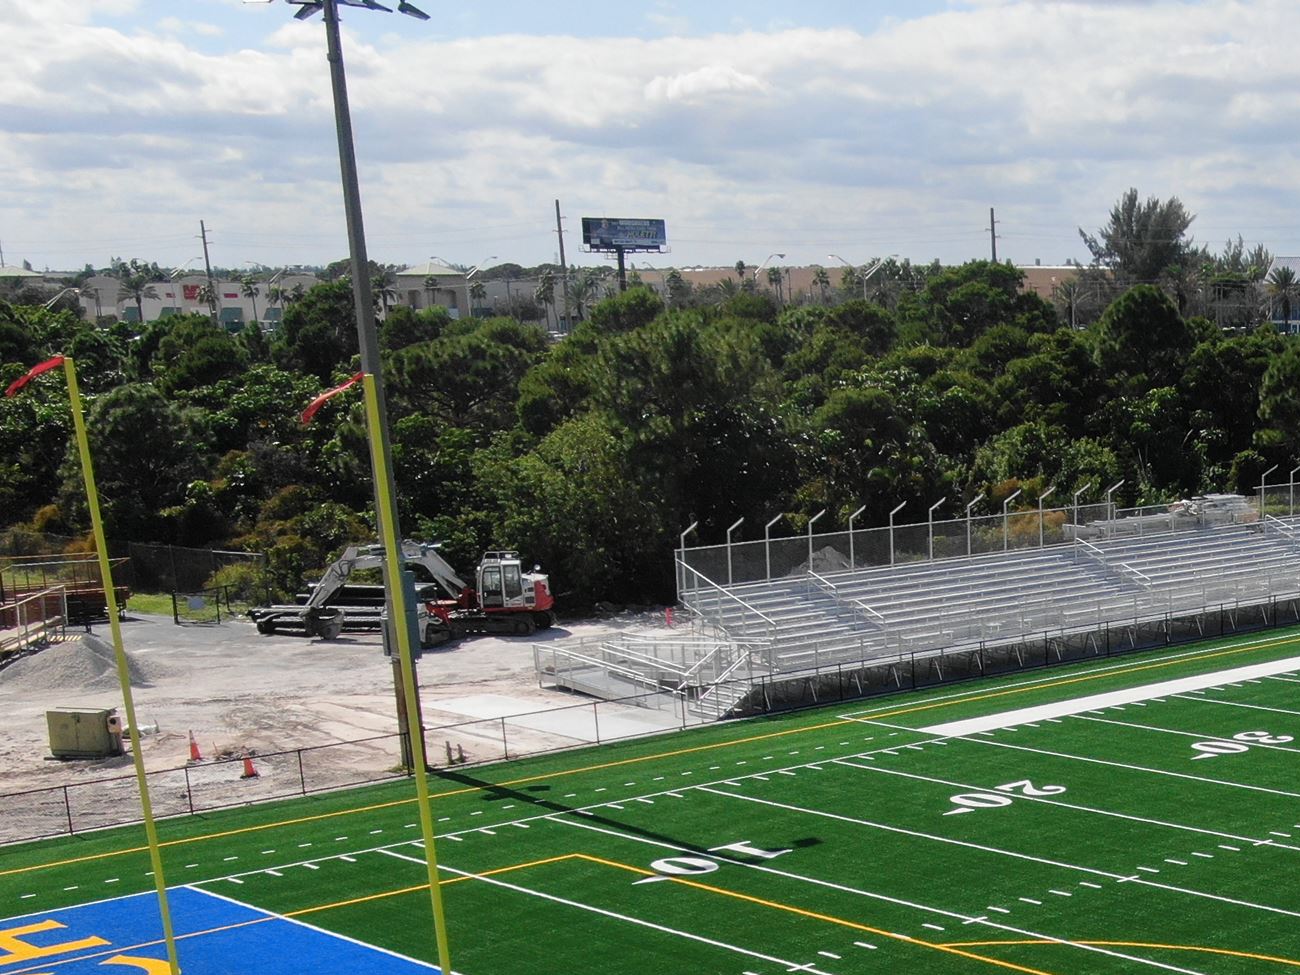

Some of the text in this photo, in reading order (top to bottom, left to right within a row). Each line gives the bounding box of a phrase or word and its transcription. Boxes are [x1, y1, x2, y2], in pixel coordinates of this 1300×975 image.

[1197, 730, 1295, 755] 30
[956, 779, 1066, 809] 20
[648, 840, 793, 876] 10
